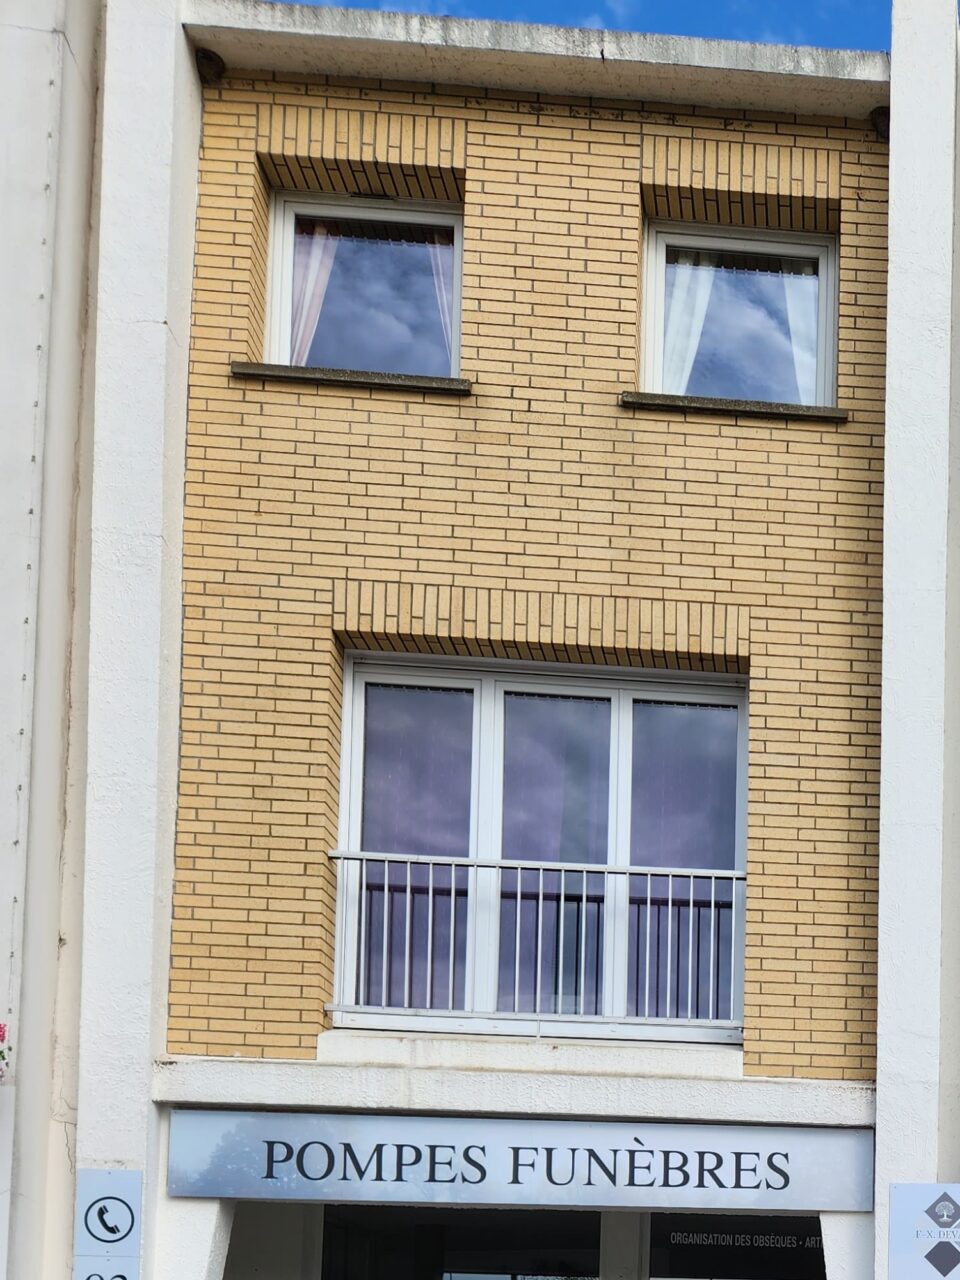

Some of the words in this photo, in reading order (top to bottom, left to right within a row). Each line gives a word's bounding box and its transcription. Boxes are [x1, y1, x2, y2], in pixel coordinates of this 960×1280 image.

[261, 1140, 487, 1185] POMPES
[507, 1136, 790, 1190] FUNÈBRES
[670, 1231, 733, 1246] ORGANISATION
[734, 1234, 750, 1246] DES
